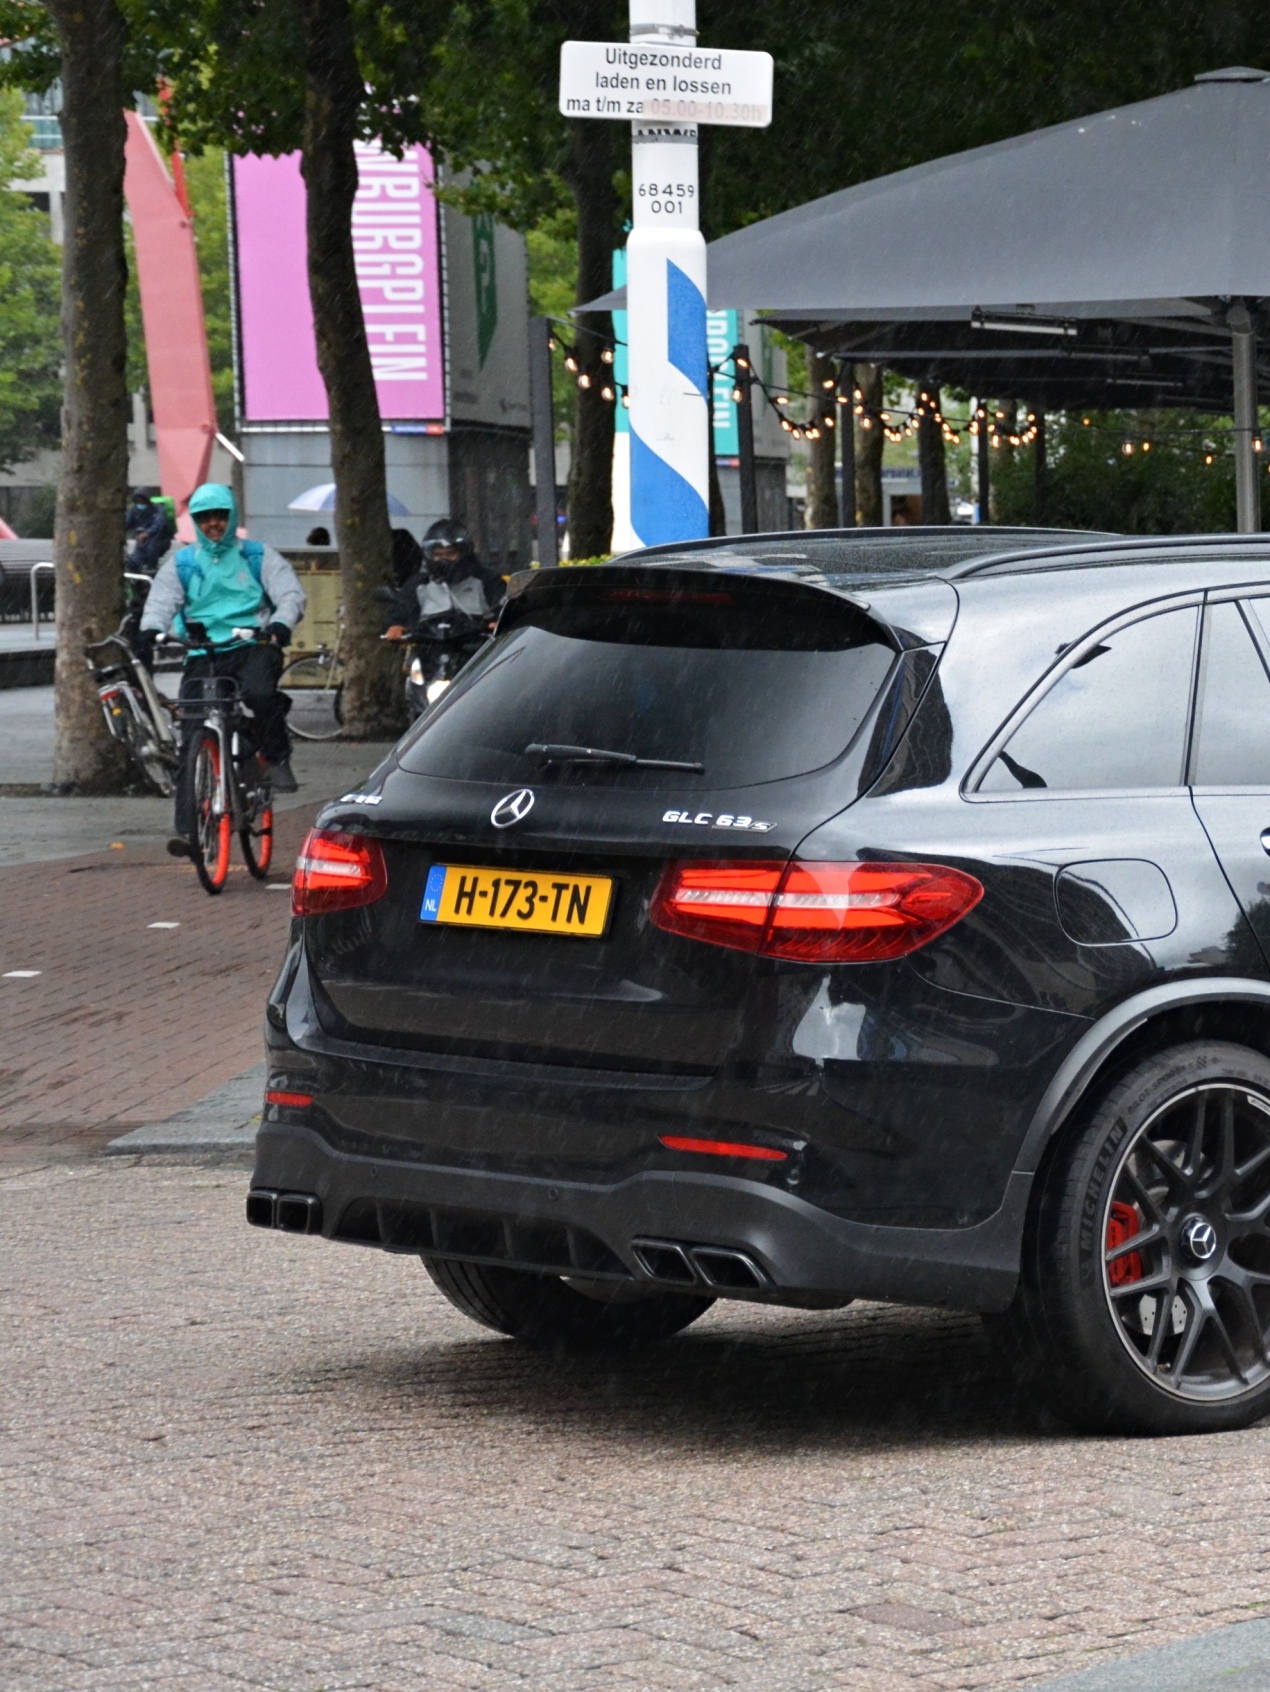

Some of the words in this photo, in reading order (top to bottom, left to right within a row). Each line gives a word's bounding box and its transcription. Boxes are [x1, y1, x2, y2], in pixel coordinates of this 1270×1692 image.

[605, 48, 722, 70] Uitgezonderd
[595, 72, 640, 91] laden
[646, 78, 666, 91] en
[673, 76, 732, 95] lossen
[566, 98, 590, 113] ma
[596, 97, 621, 113] t/m
[627, 101, 644, 114] za
[638, 183, 695, 198] 68459
[651, 201, 683, 214] 001
[662, 810, 713, 825] GLC
[424, 899, 437, 912] NL
[453, 875, 593, 926] H-173-TN
[1081, 1125, 1125, 1251] MICHELIN
